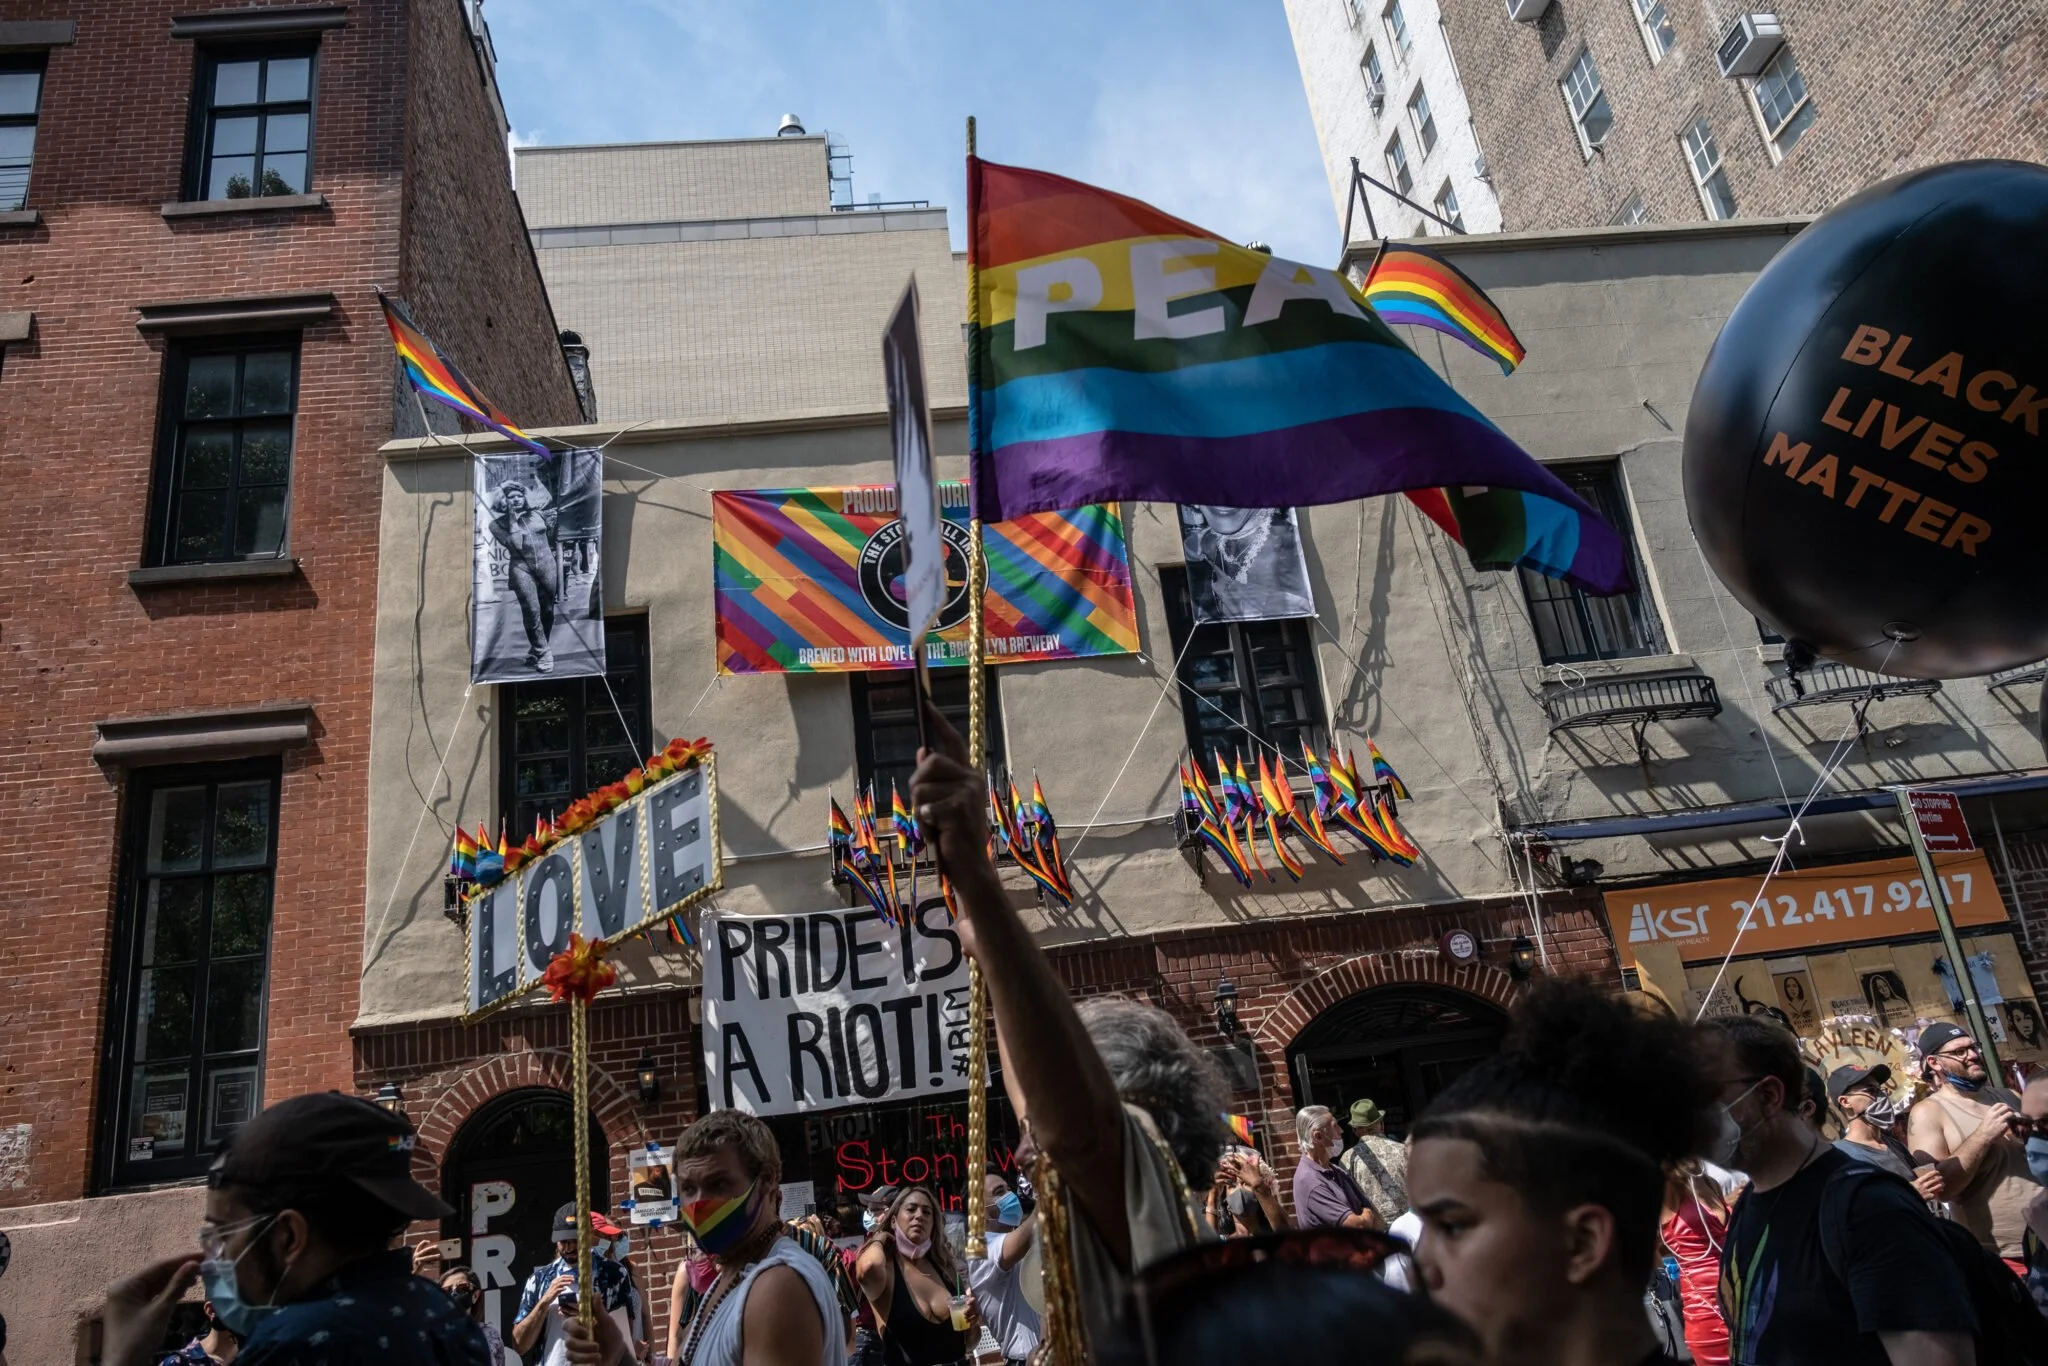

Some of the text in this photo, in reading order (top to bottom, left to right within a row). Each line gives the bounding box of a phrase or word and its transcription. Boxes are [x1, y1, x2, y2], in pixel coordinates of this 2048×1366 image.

[1840, 323, 2048, 437] BLACK
[1821, 386, 1999, 484] LIVES
[842, 487, 897, 514] PROUD
[1762, 431, 1992, 557] MATTER
[863, 542, 884, 565] THE
[799, 647, 845, 664] BREWED
[847, 646, 876, 663] WITH
[879, 645, 906, 662] LOVE
[926, 642, 947, 659] THE
[949, 637, 1007, 658] BROLYN
[1009, 633, 1060, 654] BREWERY
[1911, 797, 1952, 810] NO STOPPING
[1918, 811, 1943, 824] Anytime
[478, 771, 705, 1009] LOVE
[717, 896, 963, 1002] PRIDE IS
[722, 993, 944, 1108] A RIOT!
[943, 986, 970, 1077] #BLM
[1803, 1027, 1893, 1068] LAYLEEN
[926, 1114, 965, 1139] Th
[939, 1187, 963, 1212] In
[472, 1179, 524, 1366] PRI
